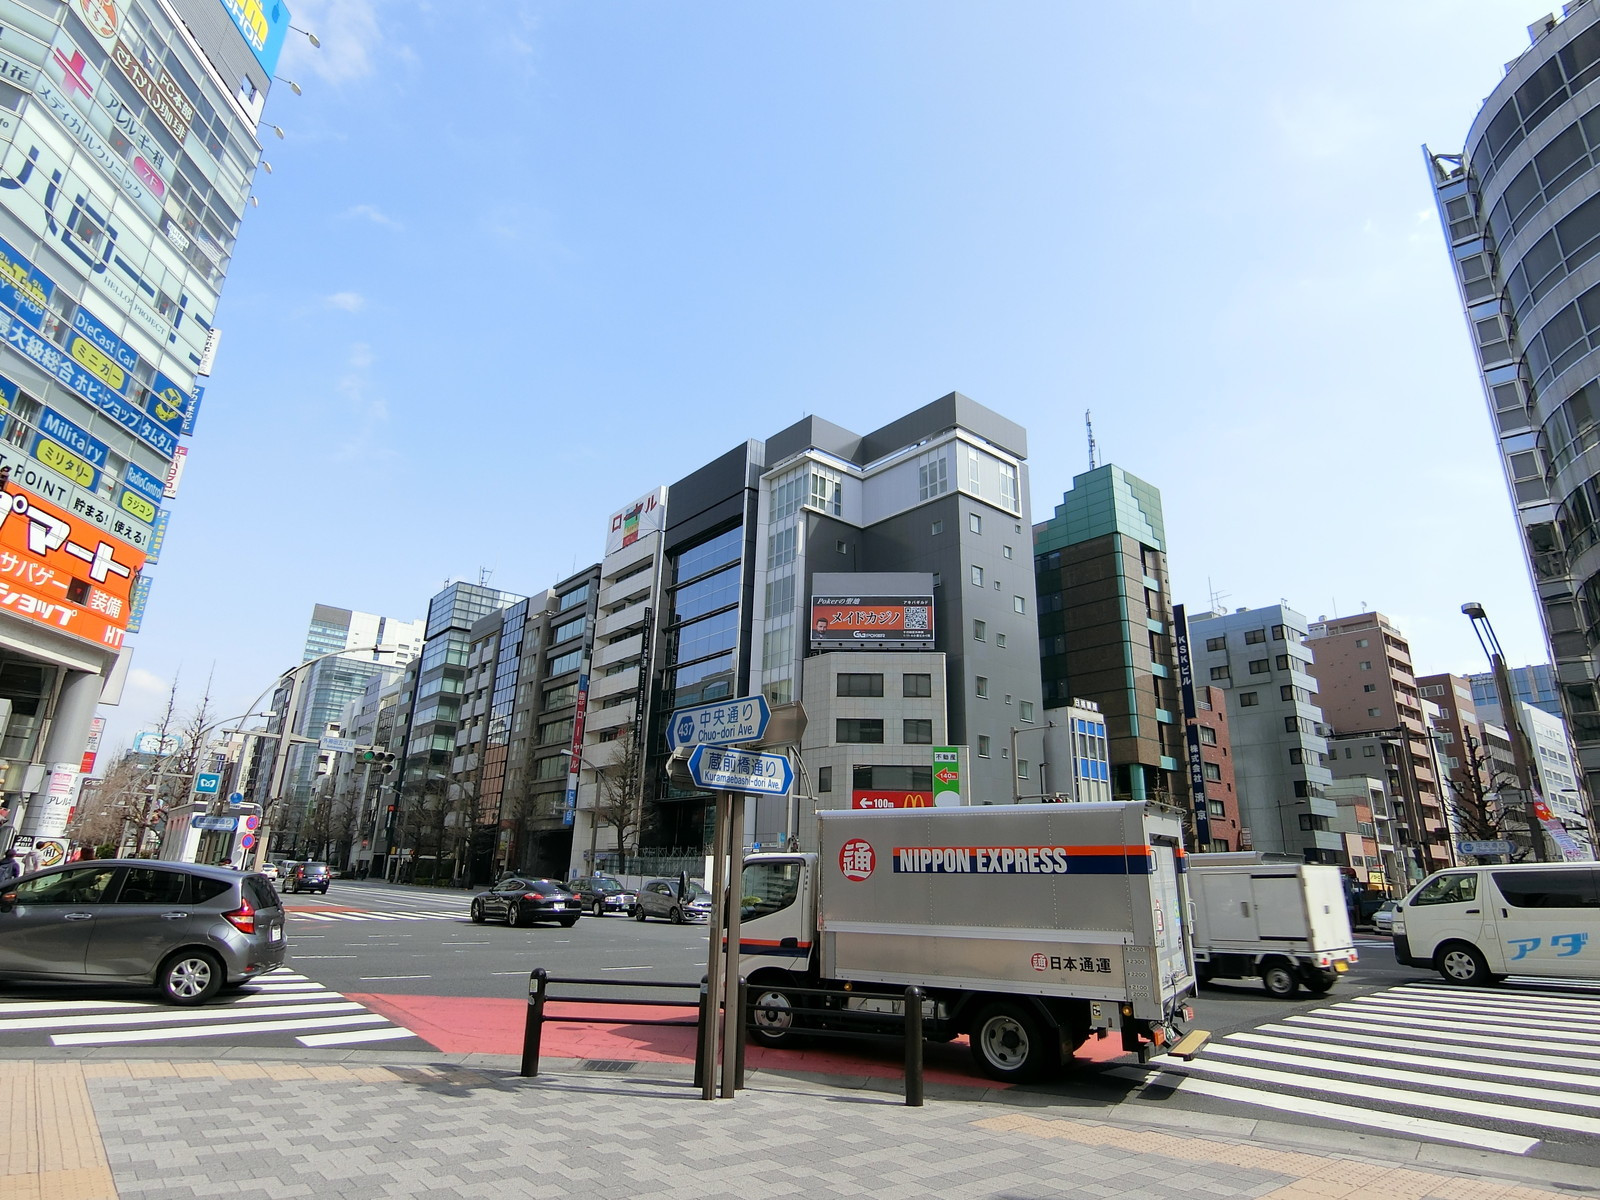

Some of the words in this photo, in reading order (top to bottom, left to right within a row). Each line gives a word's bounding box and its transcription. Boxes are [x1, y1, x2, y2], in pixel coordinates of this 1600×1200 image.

[116, 45, 187, 141] さかい珈琲
[160, 72, 194, 122] FC本部
[37, 84, 143, 200] メディカルクリニック
[106, 93, 165, 171] アレルギー科
[142, 170, 159, 187] 7F
[13, 289, 43, 316] SHOP
[134, 303, 167, 337] PROJECT
[75, 312, 115, 353] DieCast
[118, 350, 136, 369] Car
[78, 344, 121, 383] ミニカー
[44, 413, 103, 461] Military
[142, 421, 173, 455] タムタム
[45, 446, 89, 479] ミリタリー
[13, 464, 67, 502] POINT
[126, 466, 163, 504] RadioControl
[73, 497, 109, 525] 貯まる!
[114, 519, 147, 546] 使える!
[126, 496, 153, 518] ラジコン
[0, 551, 69, 590] サバゲー
[91, 588, 123, 620] 装備
[0, 581, 78, 627] ショップ
[829, 610, 901, 626] メイドカジノ
[103, 624, 126, 647] HT
[1178, 635, 1192, 686] KSKビル
[678, 721, 694, 737] 437
[698, 724, 736, 742] Chuo-dori
[737, 723, 754, 736] Ave.
[700, 703, 753, 728] 中央通り
[704, 770, 766, 788] Kuramaebashi-dori
[767, 779, 781, 789] Ave.
[708, 751, 777, 778] 蔵前橋通り
[1190, 743, 1202, 783] 株式会社
[873, 798, 895, 808] 100m
[842, 842, 874, 880] 通
[899, 848, 970, 873] NIPPON
[976, 847, 1068, 874] EXPRESS
[1507, 932, 1589, 961] アダ
[1032, 954, 1048, 971] 通
[1050, 956, 1112, 974] 日本通運
